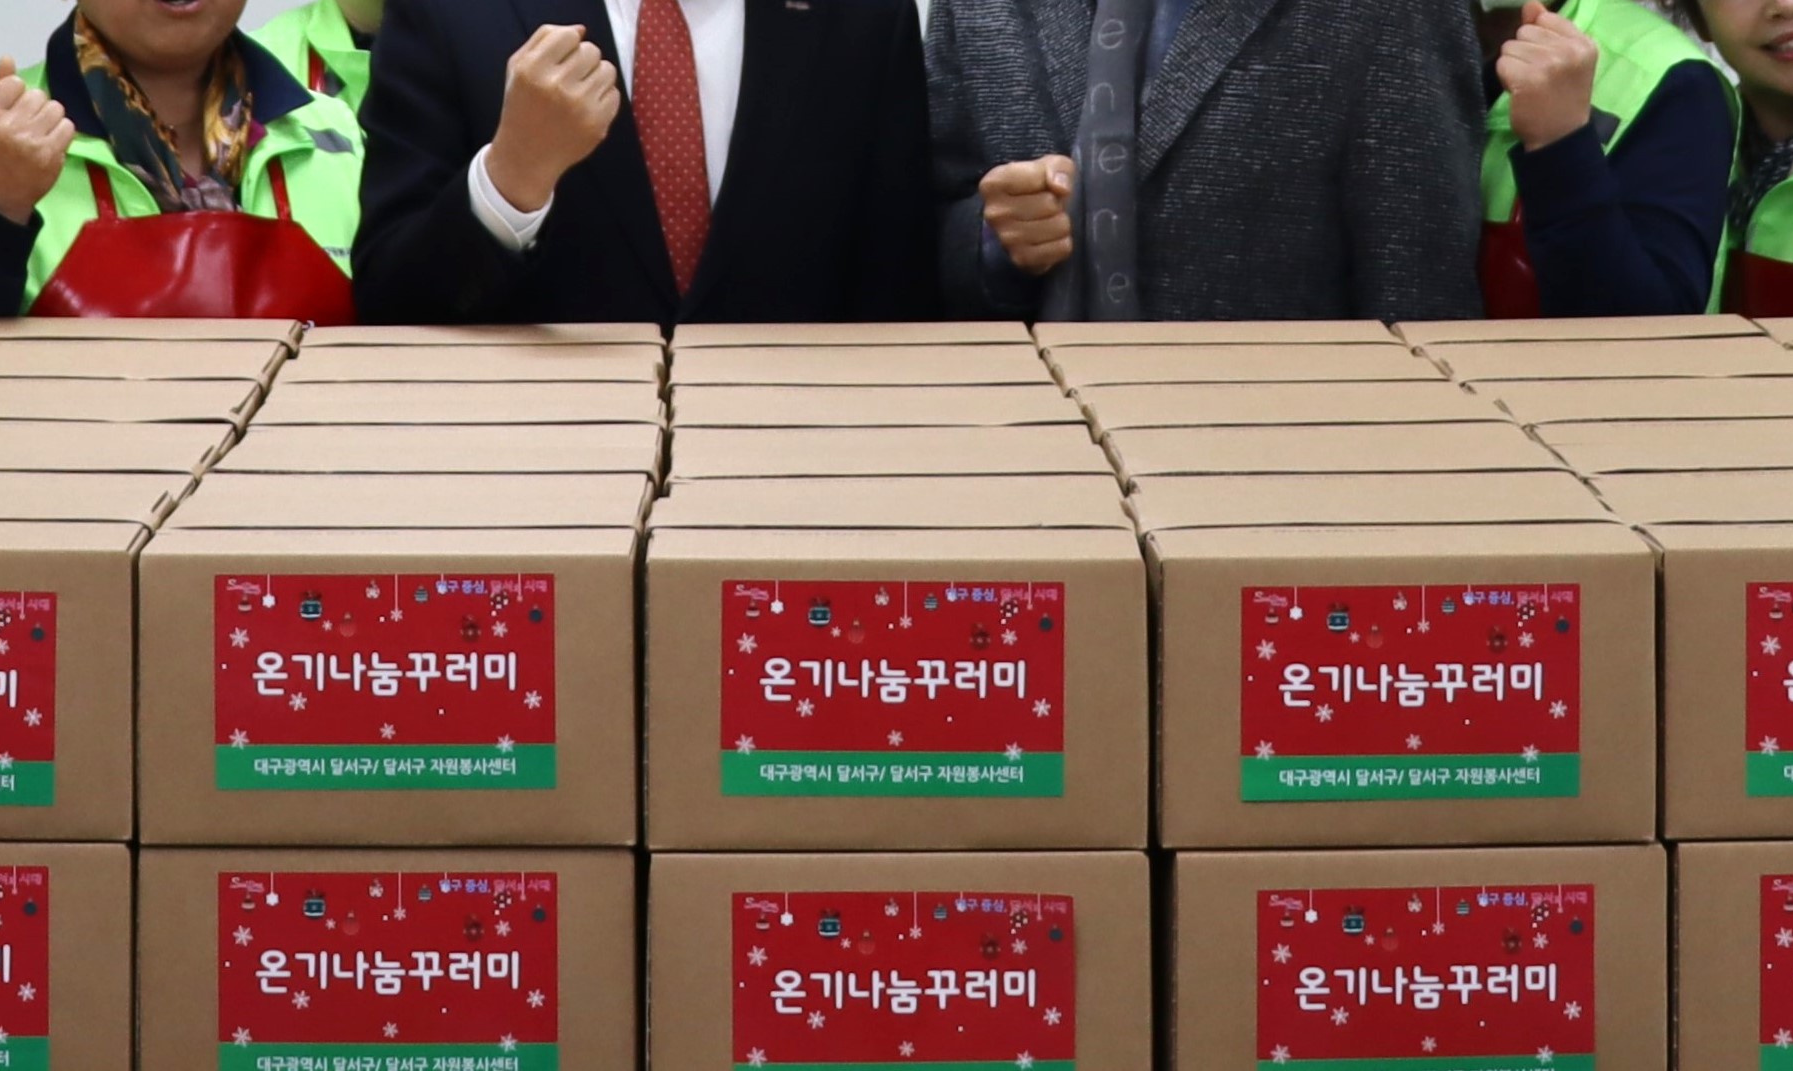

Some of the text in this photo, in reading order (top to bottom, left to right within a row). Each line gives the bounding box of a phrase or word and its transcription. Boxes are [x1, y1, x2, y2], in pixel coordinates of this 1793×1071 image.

[252, 651, 517, 699] 온기나눔꾸러미
[759, 657, 1026, 705] 온기나눔꾸러미
[1278, 662, 1543, 711] 온기나눔꾸러미
[254, 757, 516, 775] 대구광역시 달서구/ 달서구 자원봉사센터
[760, 763, 1024, 783] 대구광역시 달서구/ 달서구 자원봉사센터
[1279, 766, 1541, 787] 대구광역시 달서구/ 달서구 자원봉사센터
[255, 949, 520, 997] 온기나눔꾸러미
[770, 969, 1036, 1017] 온기나눔꾸러미
[1294, 963, 1557, 1014] 온기나눔꾸러미
